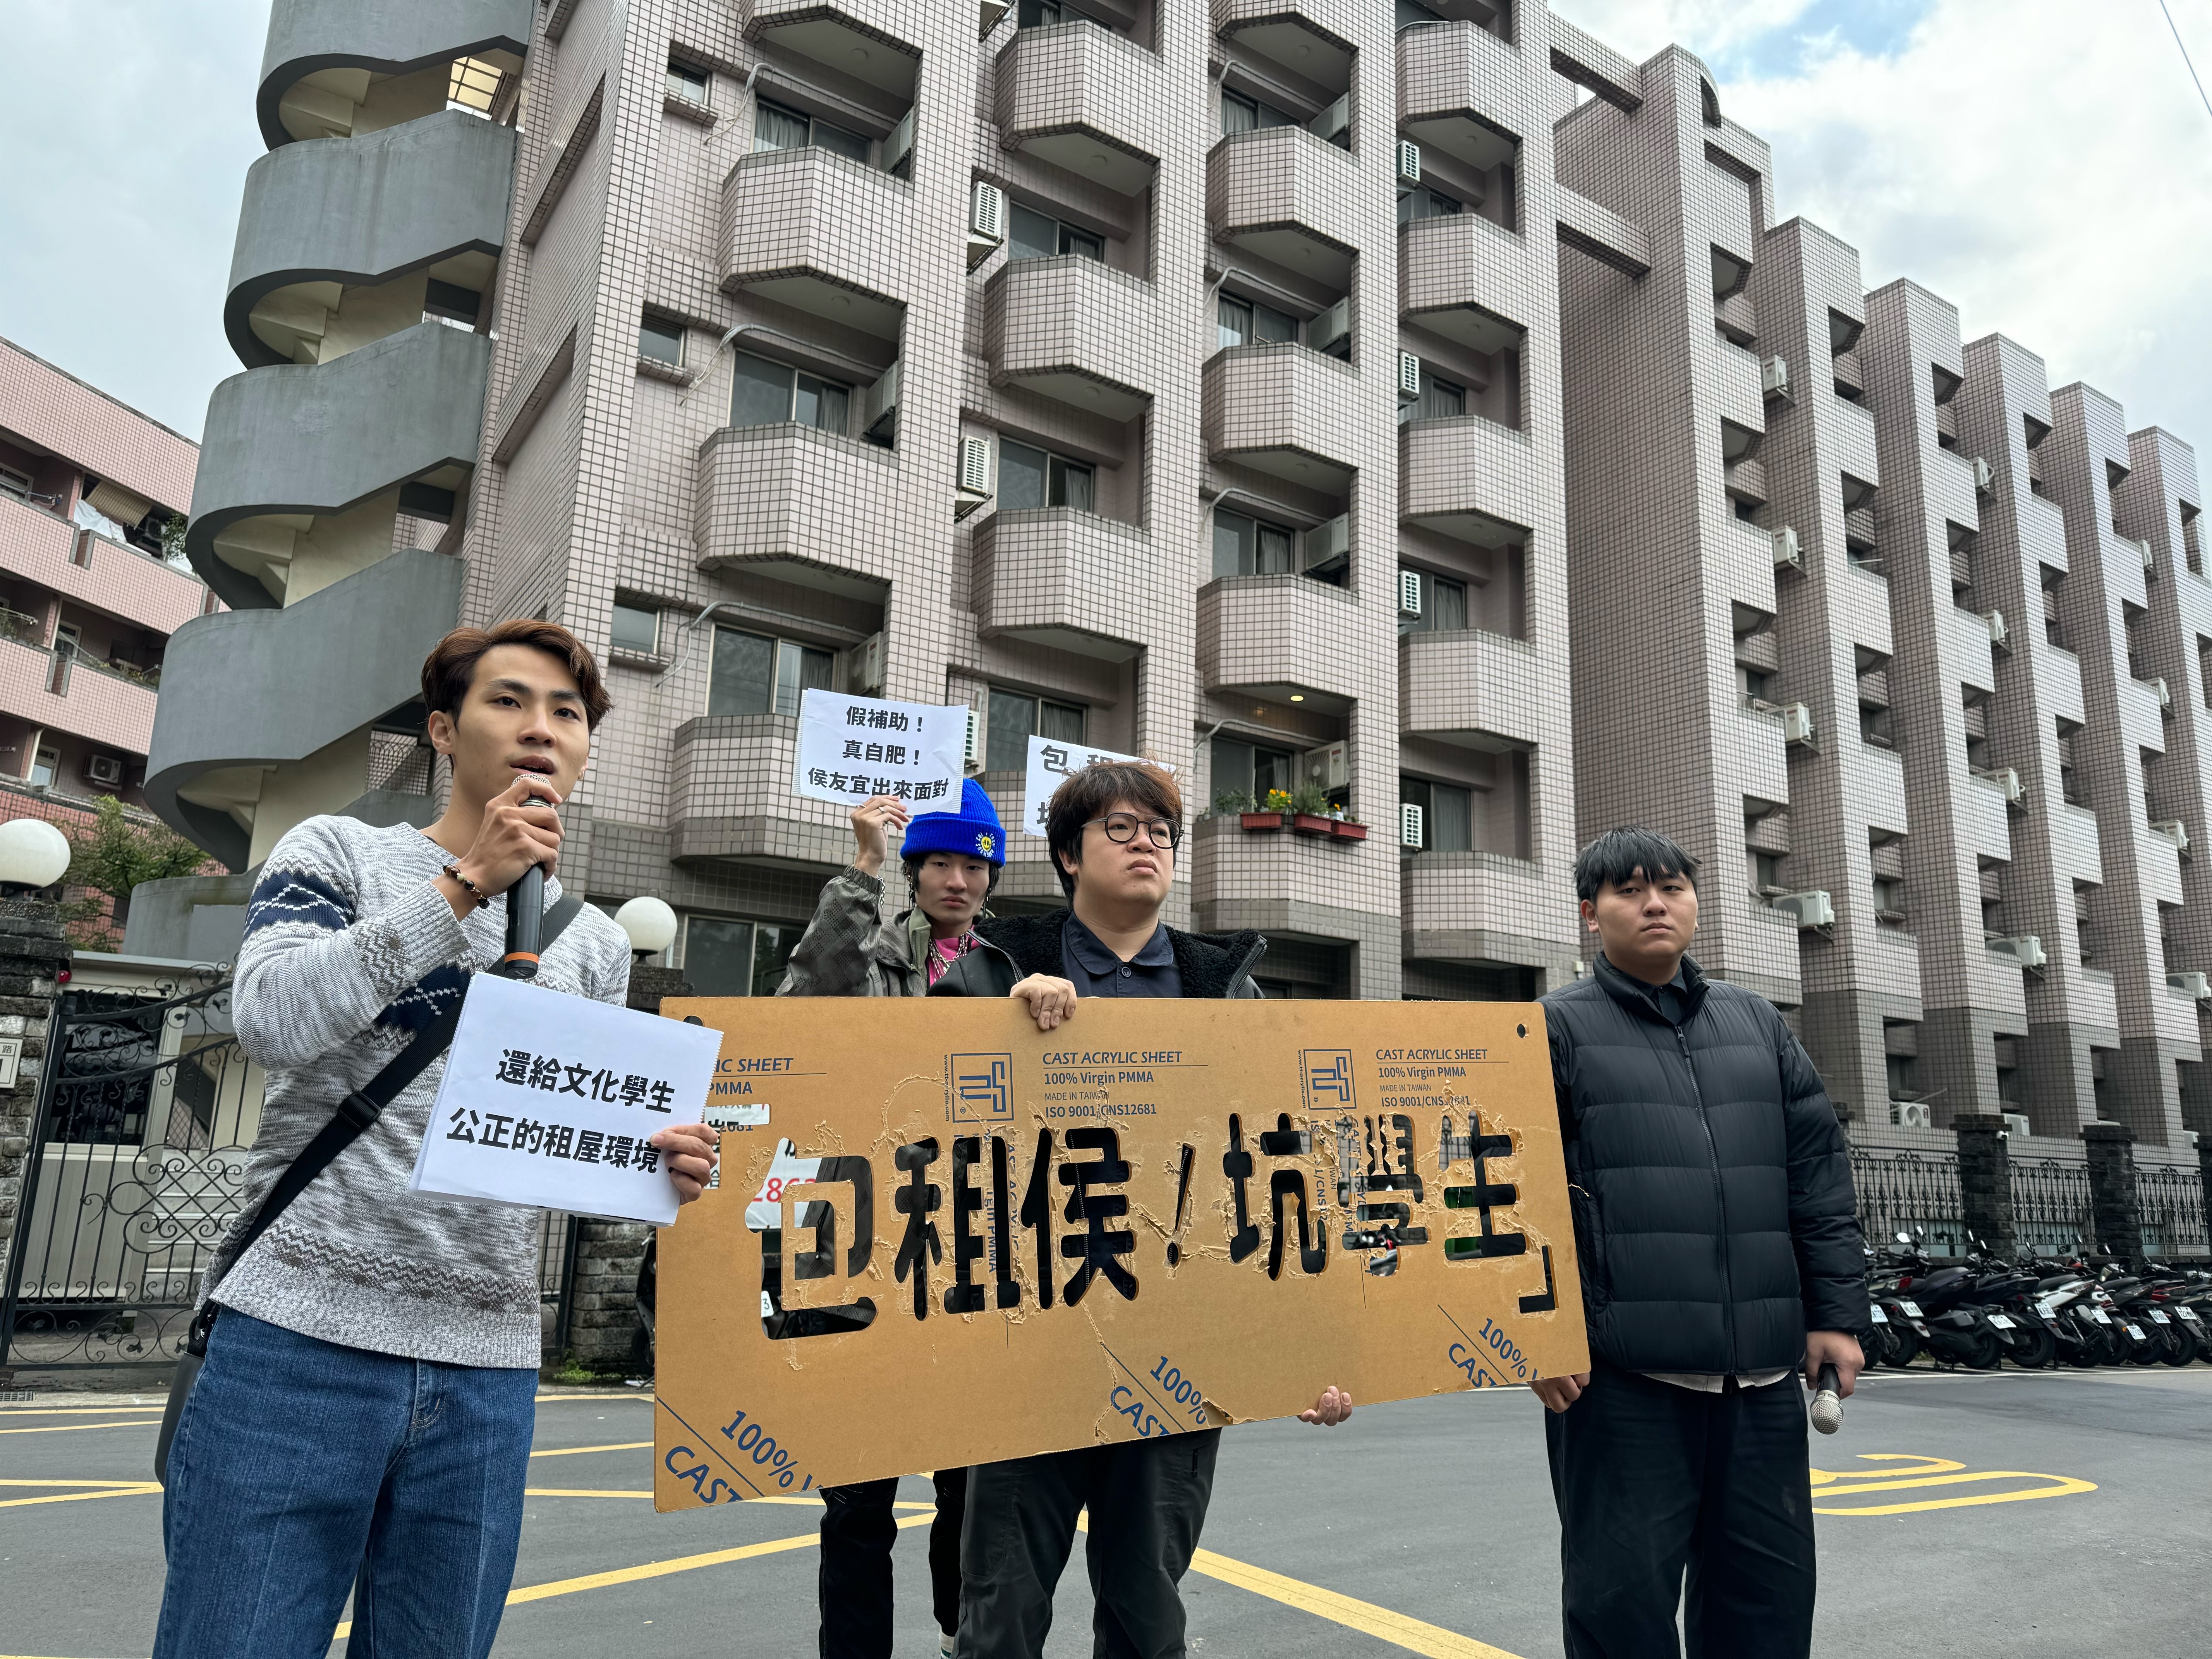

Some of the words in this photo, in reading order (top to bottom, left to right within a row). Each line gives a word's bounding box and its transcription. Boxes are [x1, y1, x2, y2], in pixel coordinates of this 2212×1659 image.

[846, 706, 923, 732] 假補助！
[842, 740, 919, 765] 真自肥！
[808, 767, 949, 801] 侯友宜出來面對
[1042, 1053, 1079, 1065] CAST
[1081, 1052, 1138, 1064] ACRYLIC
[1141, 1051, 1182, 1063] SHEET
[1376, 1049, 1404, 1060] CAST
[1407, 1049, 1452, 1060] ACRYLIC
[1455, 1049, 1488, 1060] SHEET
[737, 1058, 794, 1072] SHEET
[1378, 1067, 1405, 1078] 100%
[1407, 1066, 1435, 1080] Virgin
[1437, 1066, 1467, 1077] PMMA
[495, 1049, 675, 1114] 還給文化學生
[1044, 1072, 1078, 1085] 100%
[1080, 1071, 1115, 1085] Virgin
[1118, 1071, 1154, 1083] PMMA
[1045, 1092, 1067, 1101] MADE
[1069, 1092, 1077, 1100] IN
[1381, 1097, 1397, 1107] ISO
[1046, 1106, 1065, 1118] ISO
[446, 1107, 662, 1174] 公正的租屋環境
[1479, 1318, 1528, 1378] 100%
[1150, 1356, 1206, 1425] 100%
[721, 1410, 798, 1488] 100%
